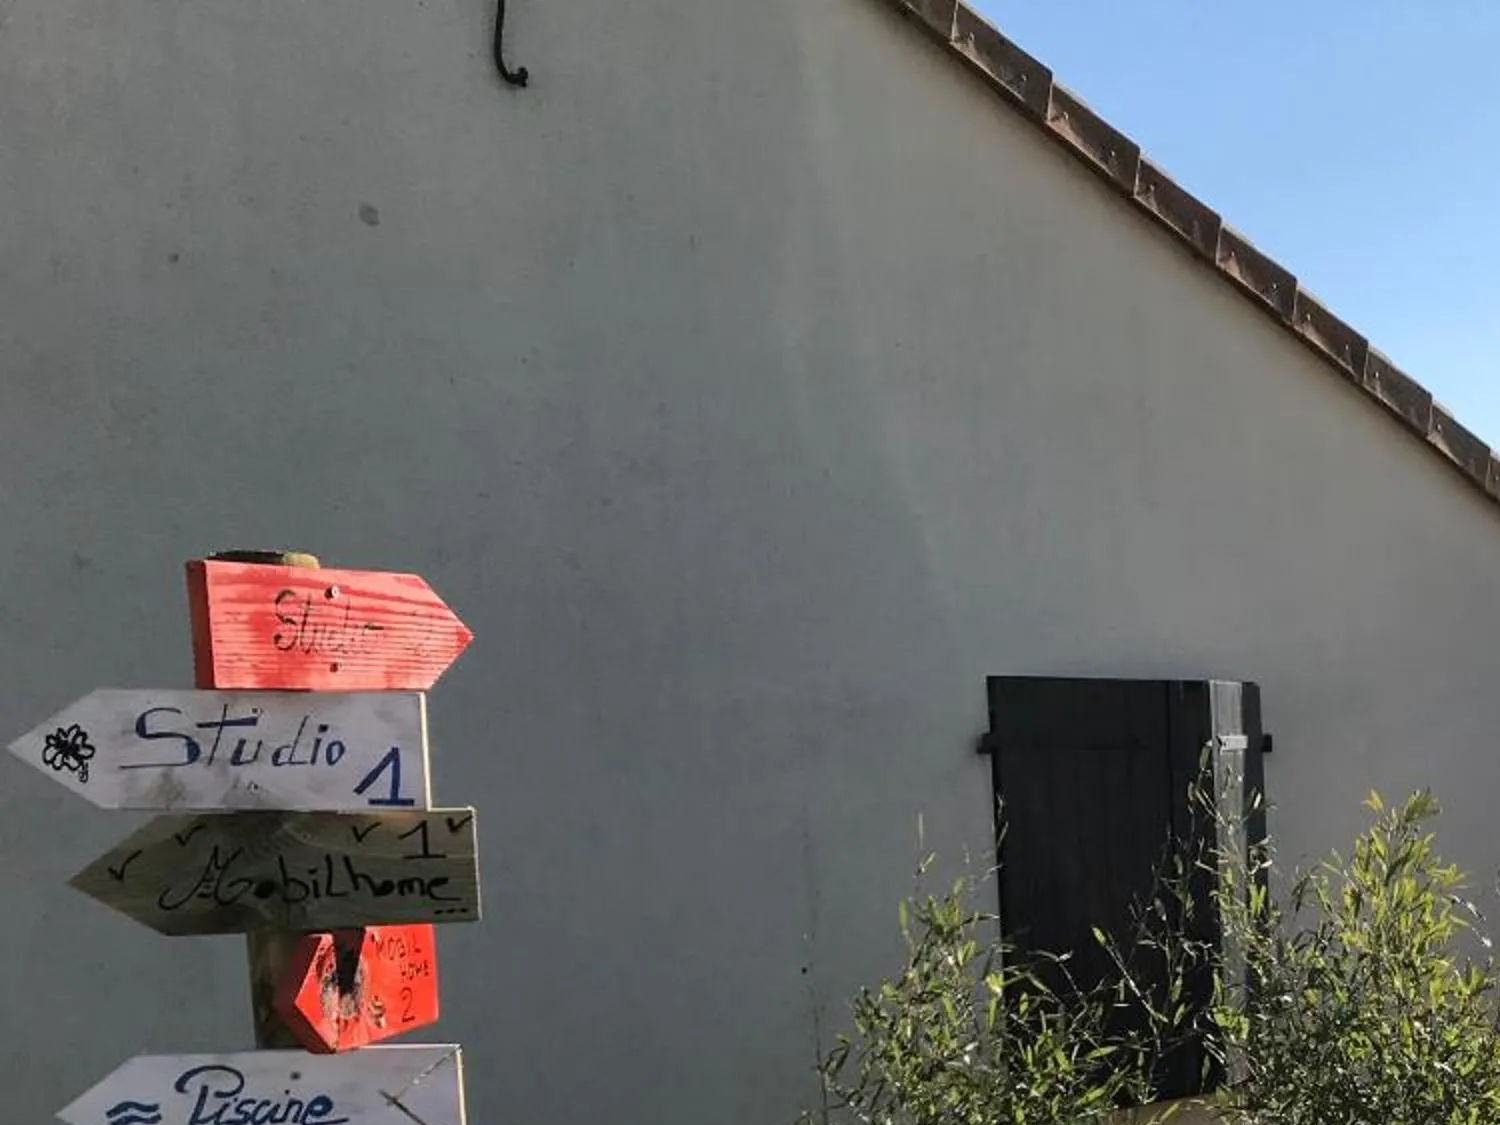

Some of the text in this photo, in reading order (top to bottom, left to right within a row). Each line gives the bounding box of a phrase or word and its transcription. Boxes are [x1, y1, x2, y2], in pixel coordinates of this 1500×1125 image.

[119, 703, 416, 807] Studio 1
[398, 820, 447, 859] 1
[400, 987, 416, 1022] 2
